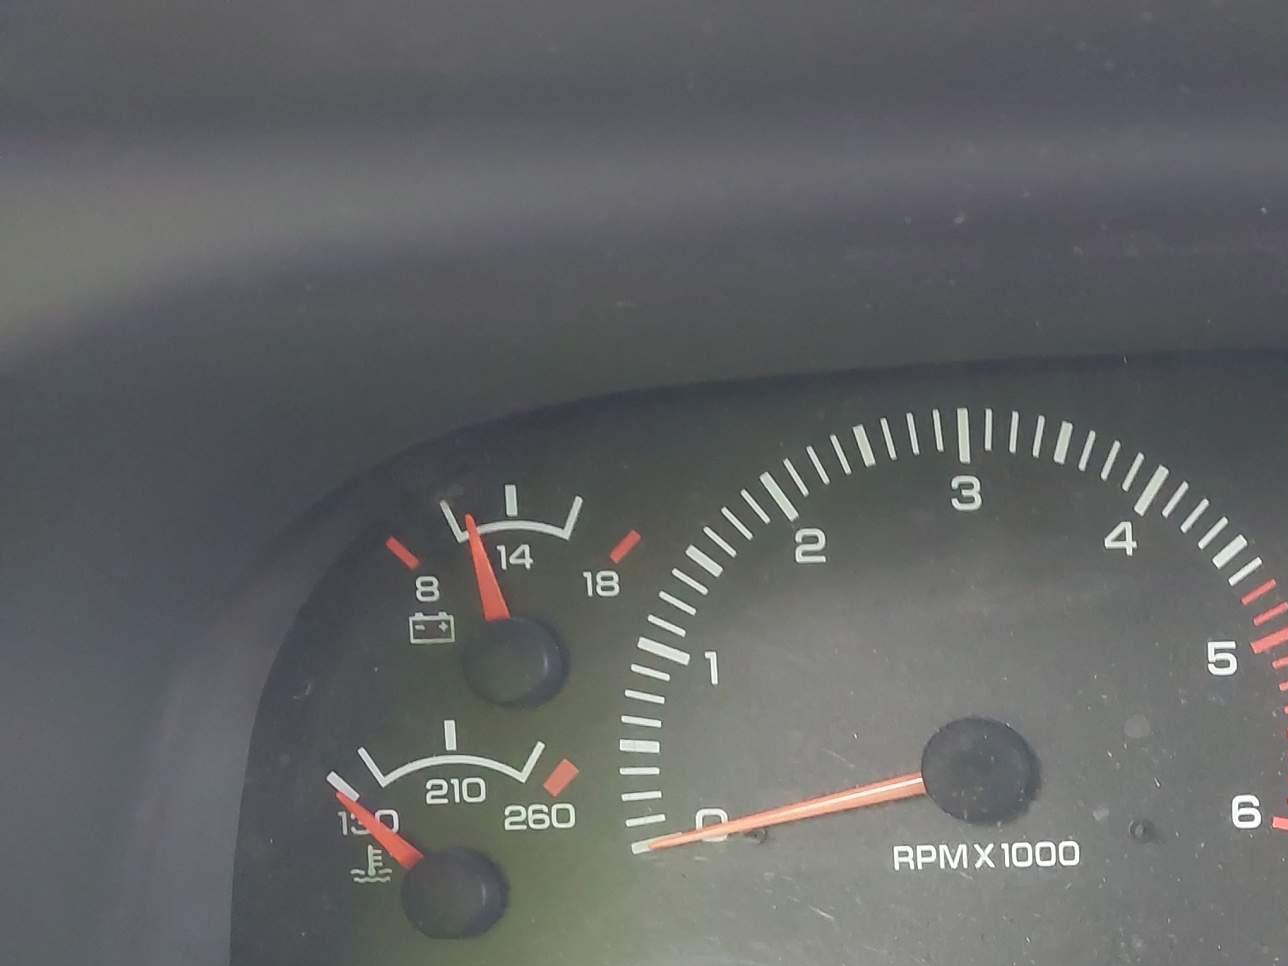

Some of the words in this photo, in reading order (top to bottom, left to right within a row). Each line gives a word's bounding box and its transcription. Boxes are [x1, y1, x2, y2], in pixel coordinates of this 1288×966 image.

[951, 475, 983, 511] 3
[795, 528, 827, 564] 2
[1103, 521, 1138, 556] 4
[496, 544, 534, 570] 14
[415, 576, 441, 602] 8
[582, 570, 620, 597] 18
[704, 651, 720, 685] 1
[1206, 640, 1237, 676] 5
[425, 776, 487, 805] 210
[504, 803, 577, 831] 260
[1231, 794, 1263, 829] 6
[893, 843, 969, 871] RPM
[1001, 840, 1080, 868] 1000
